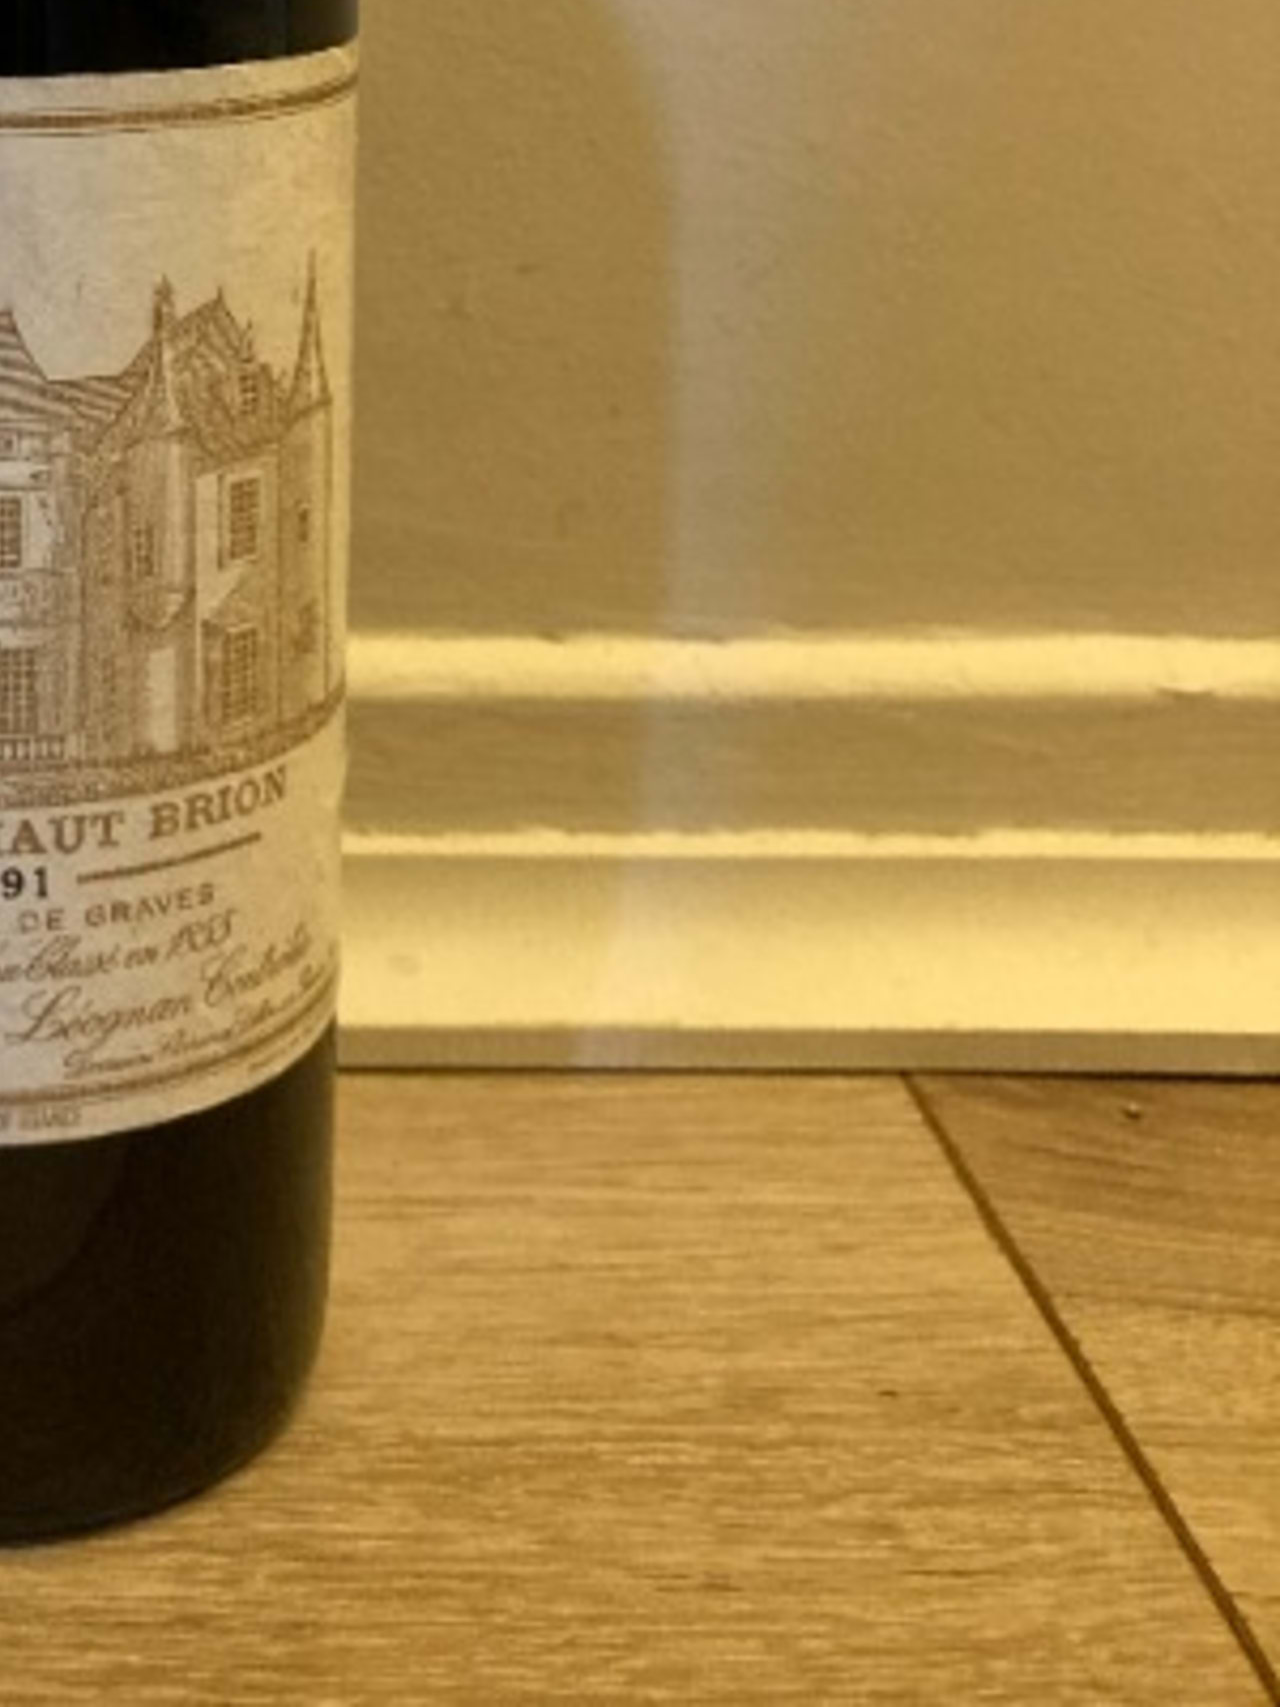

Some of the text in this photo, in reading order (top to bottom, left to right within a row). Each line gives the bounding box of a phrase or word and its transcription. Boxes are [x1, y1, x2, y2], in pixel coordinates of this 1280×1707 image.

[148, 767, 286, 840] BRION
[19, 908, 65, 935] DE
[84, 883, 214, 927] GRAVES
